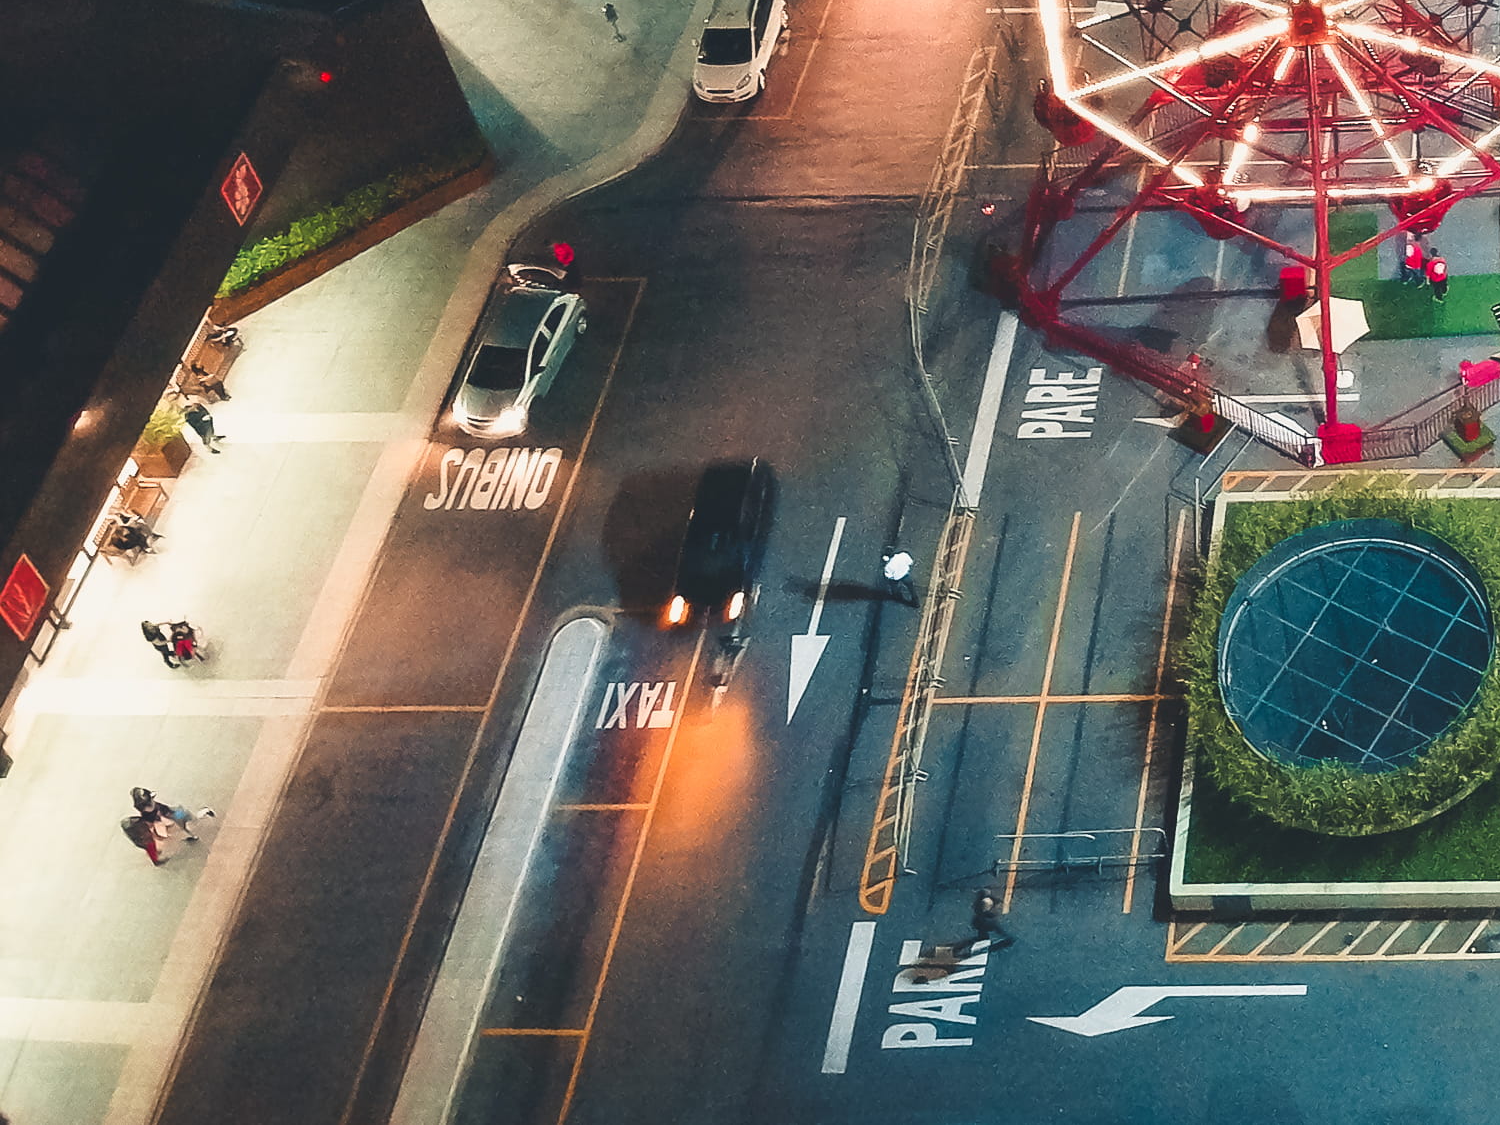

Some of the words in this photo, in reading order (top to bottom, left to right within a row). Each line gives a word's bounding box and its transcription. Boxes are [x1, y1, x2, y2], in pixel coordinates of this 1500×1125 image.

[1016, 366, 1103, 440] PARE
[423, 447, 563, 511] ONIBUS
[595, 682, 677, 729] TAXI
